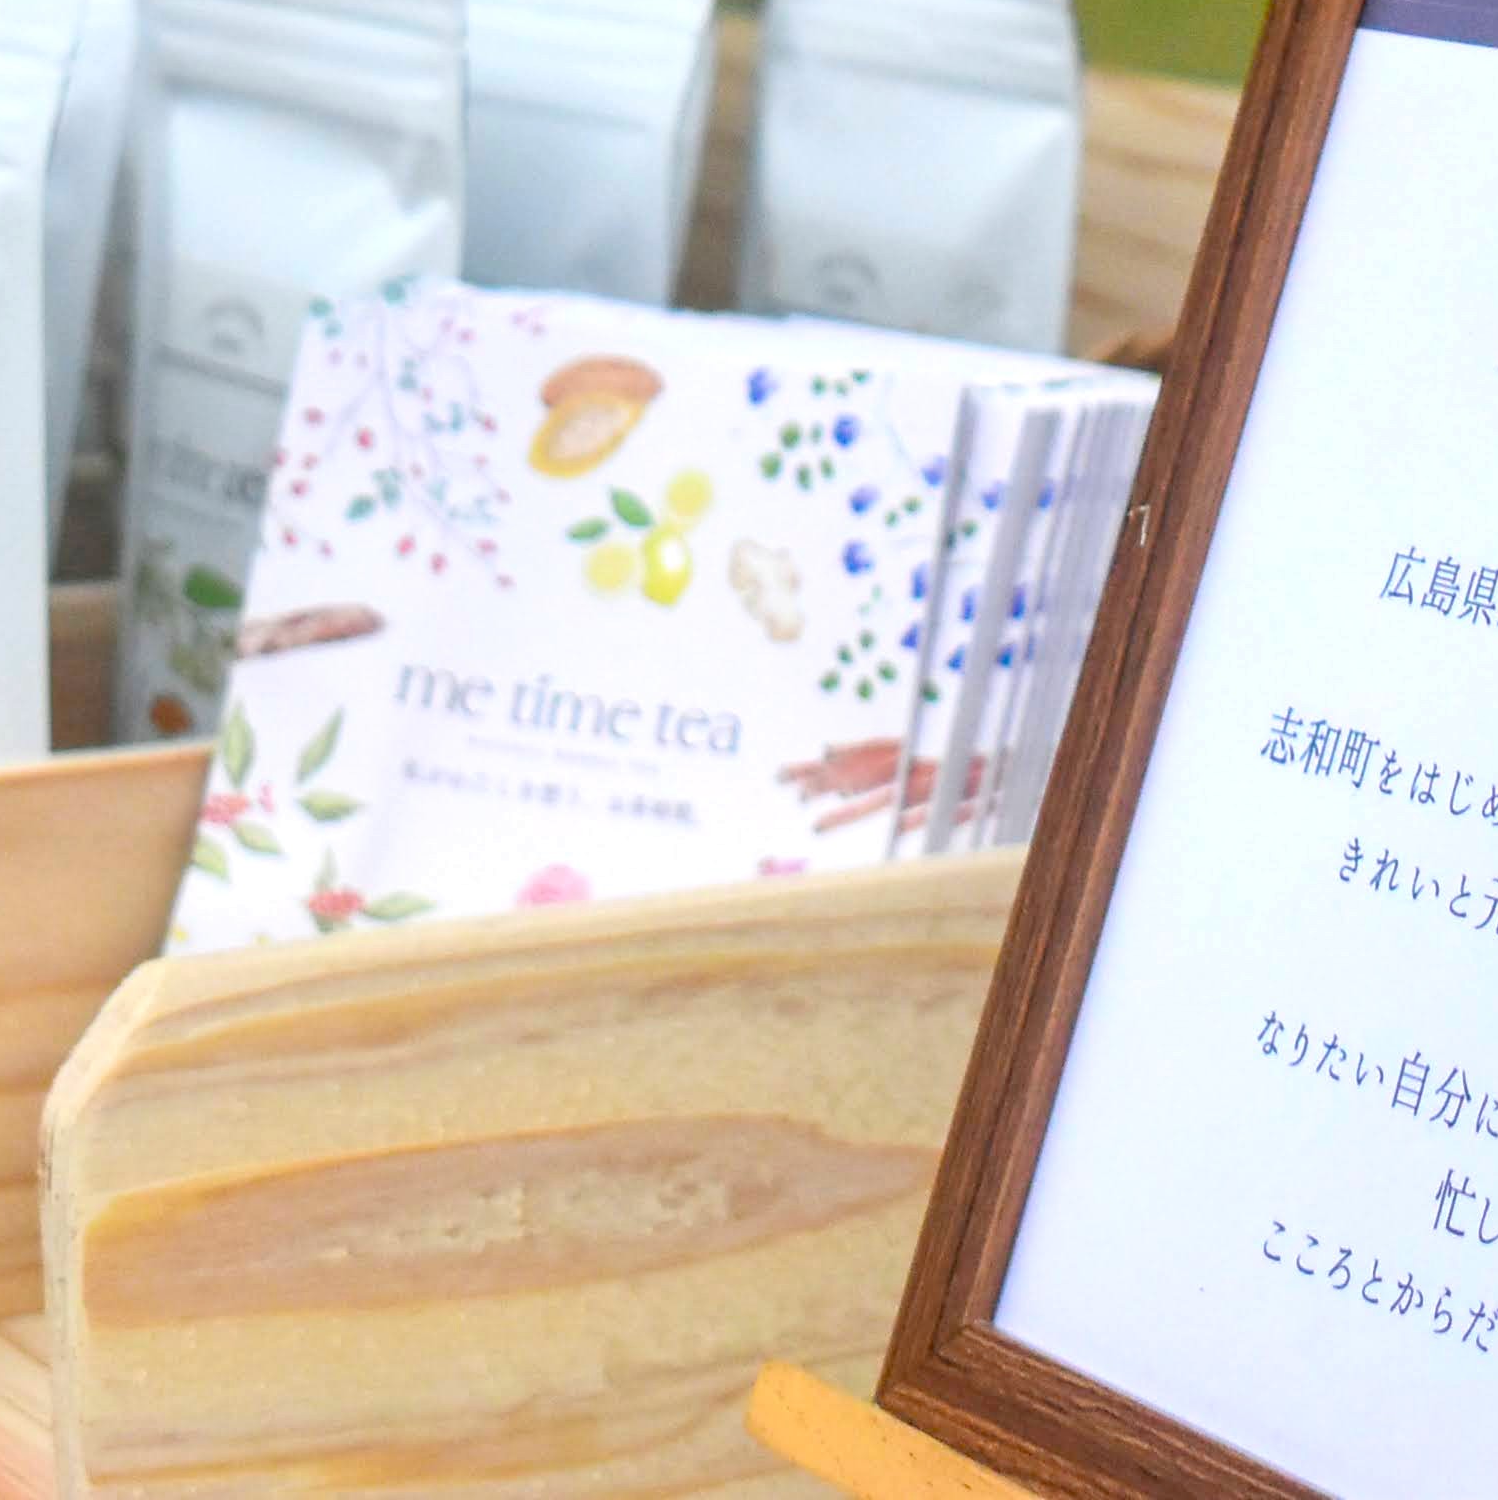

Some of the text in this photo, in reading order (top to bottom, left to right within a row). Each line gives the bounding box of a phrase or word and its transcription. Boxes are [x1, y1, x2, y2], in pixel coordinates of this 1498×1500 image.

[395, 663, 494, 717] me
[511, 673, 642, 740] time
[656, 703, 742, 755] tea
